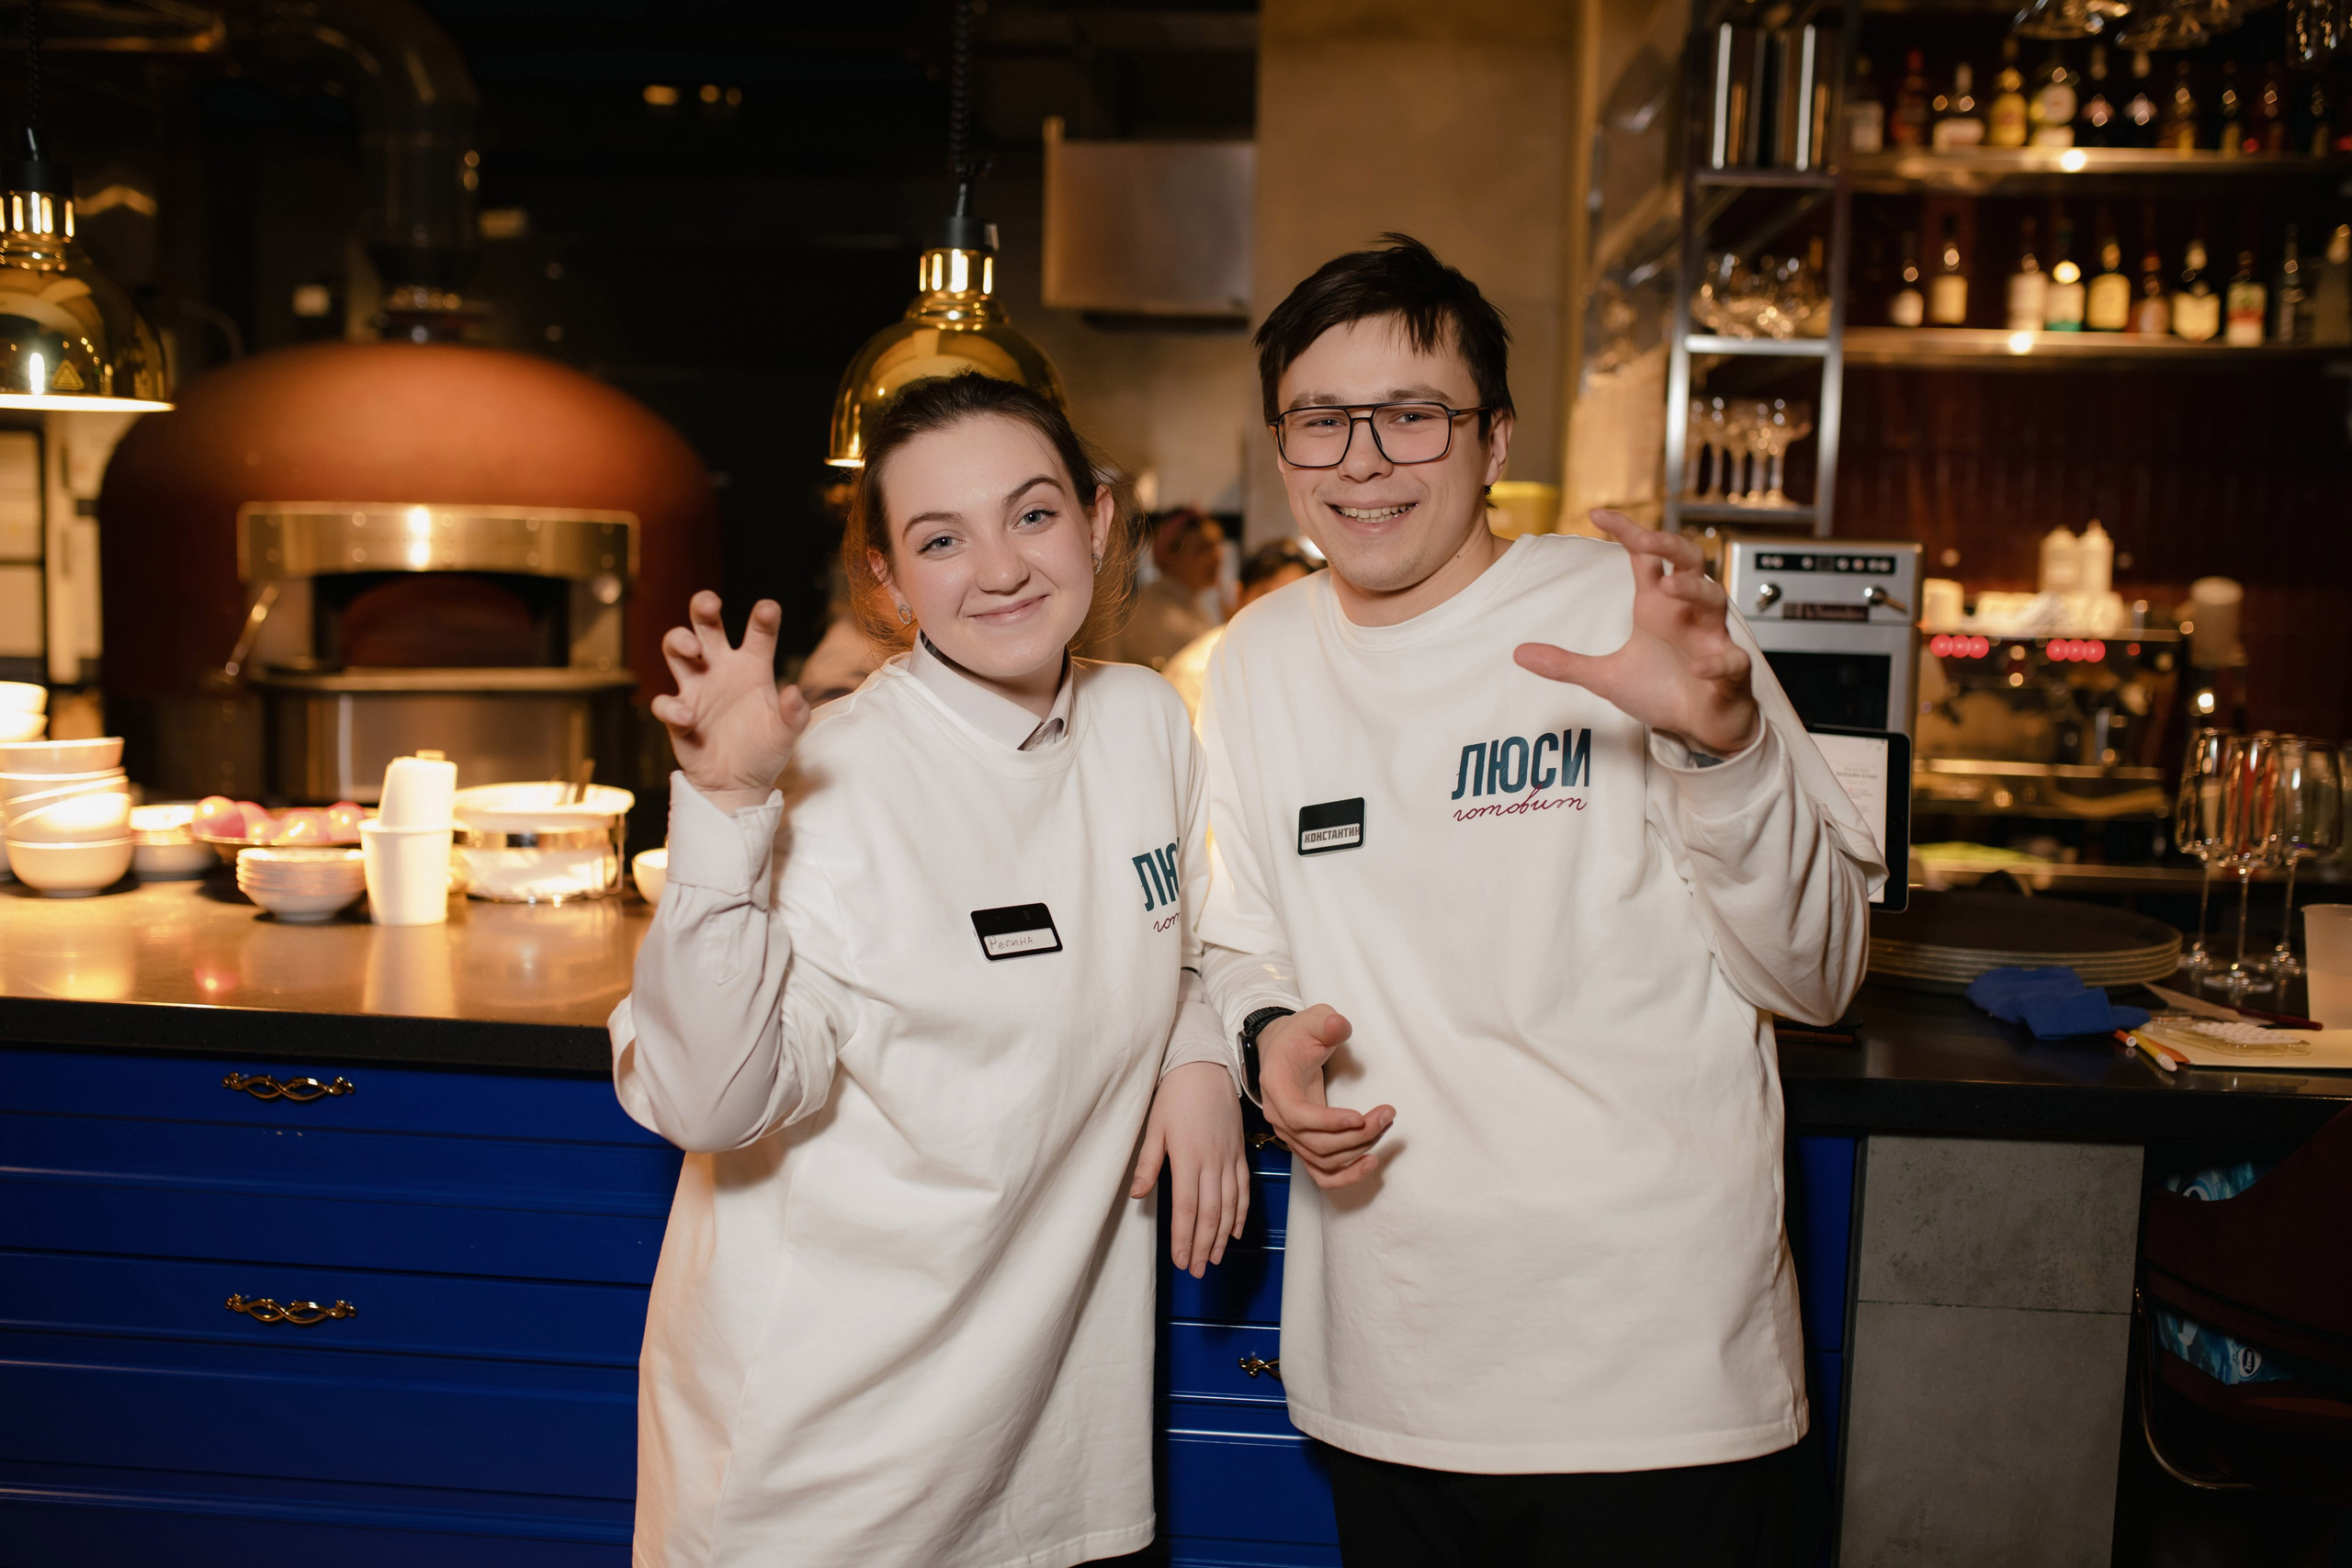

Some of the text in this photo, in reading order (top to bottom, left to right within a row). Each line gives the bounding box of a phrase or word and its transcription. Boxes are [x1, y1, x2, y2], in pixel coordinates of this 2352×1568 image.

[1452, 728, 1591, 801] ЛЮСИ
[1453, 784, 1588, 822] готовит
[1304, 825, 1361, 844] КОНСТАНТИН
[1131, 836, 1180, 912] ЛЮ
